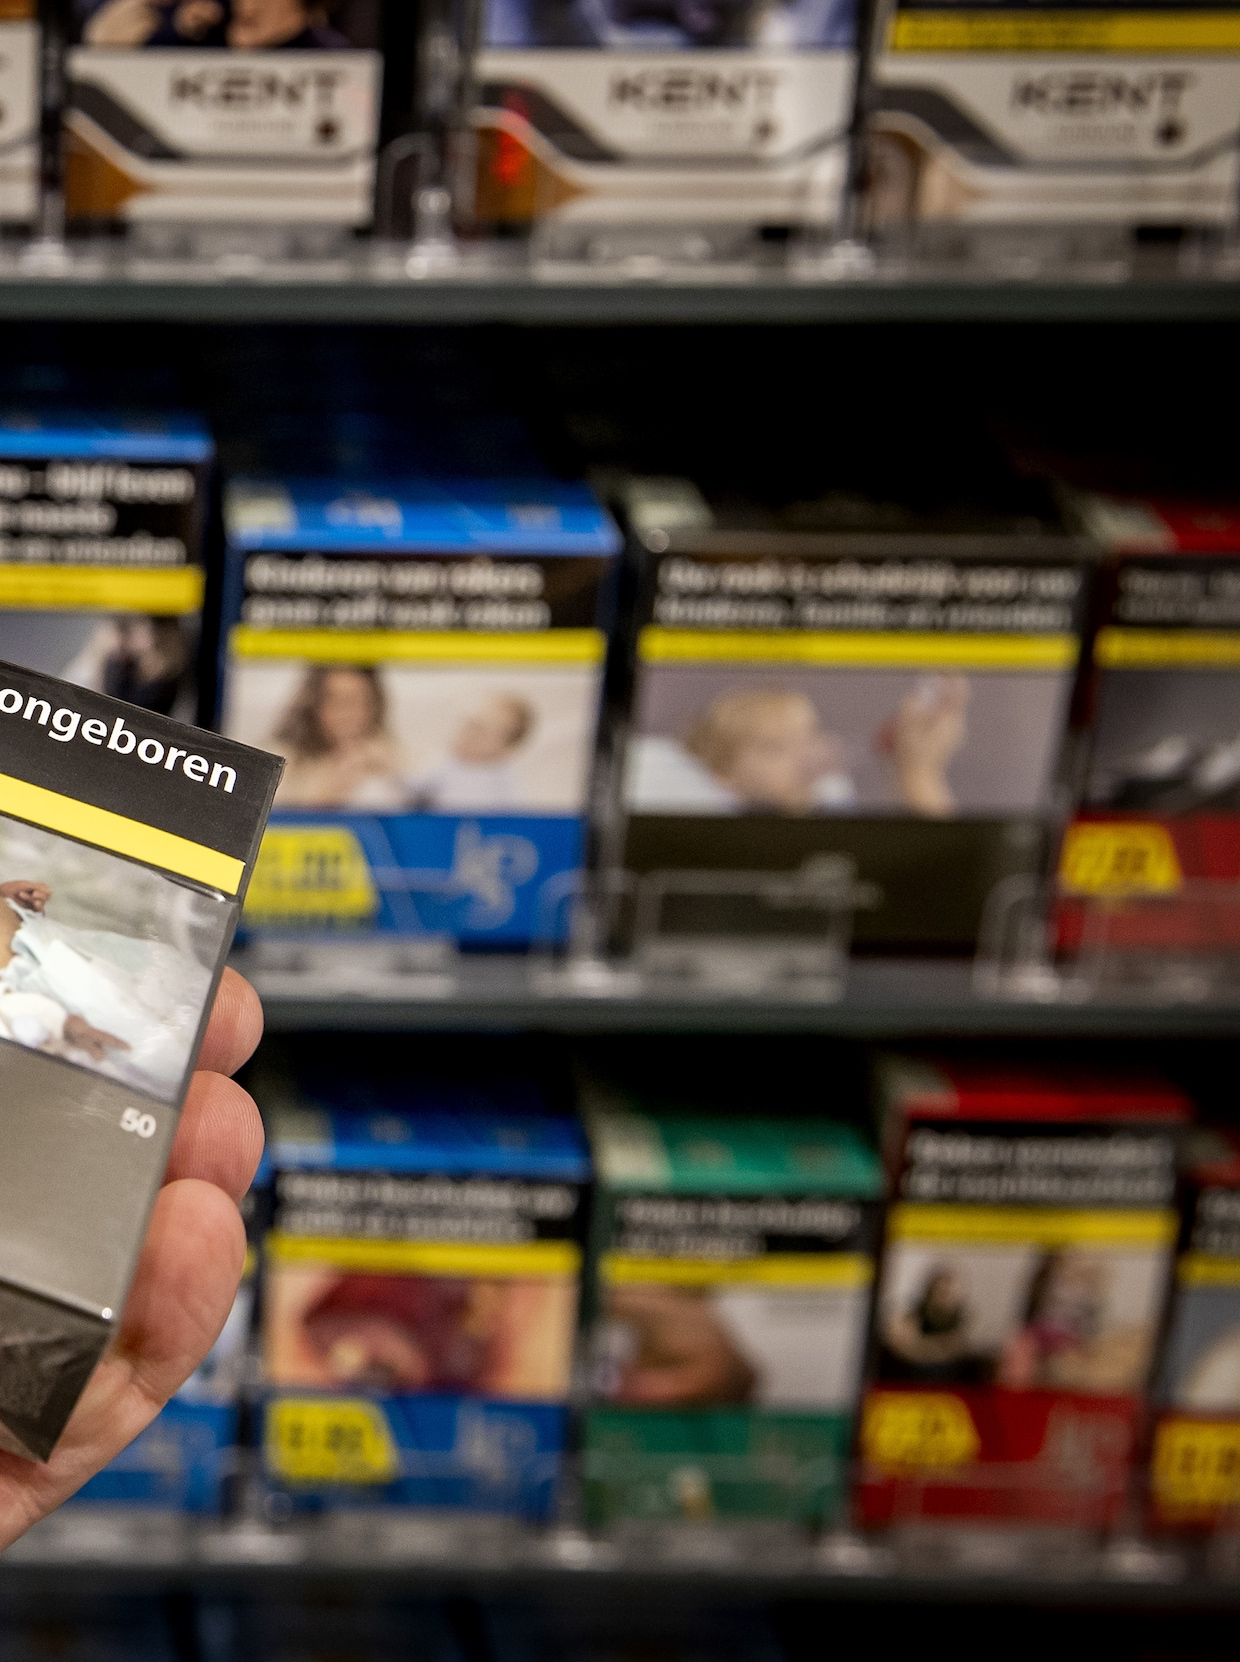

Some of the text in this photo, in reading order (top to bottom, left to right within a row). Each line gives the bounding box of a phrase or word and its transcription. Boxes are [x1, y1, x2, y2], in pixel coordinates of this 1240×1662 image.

[172, 68, 348, 111] KENT
[609, 70, 787, 111] KENT
[1011, 70, 1198, 114] KENT
[119, 1106, 157, 1139] 50
